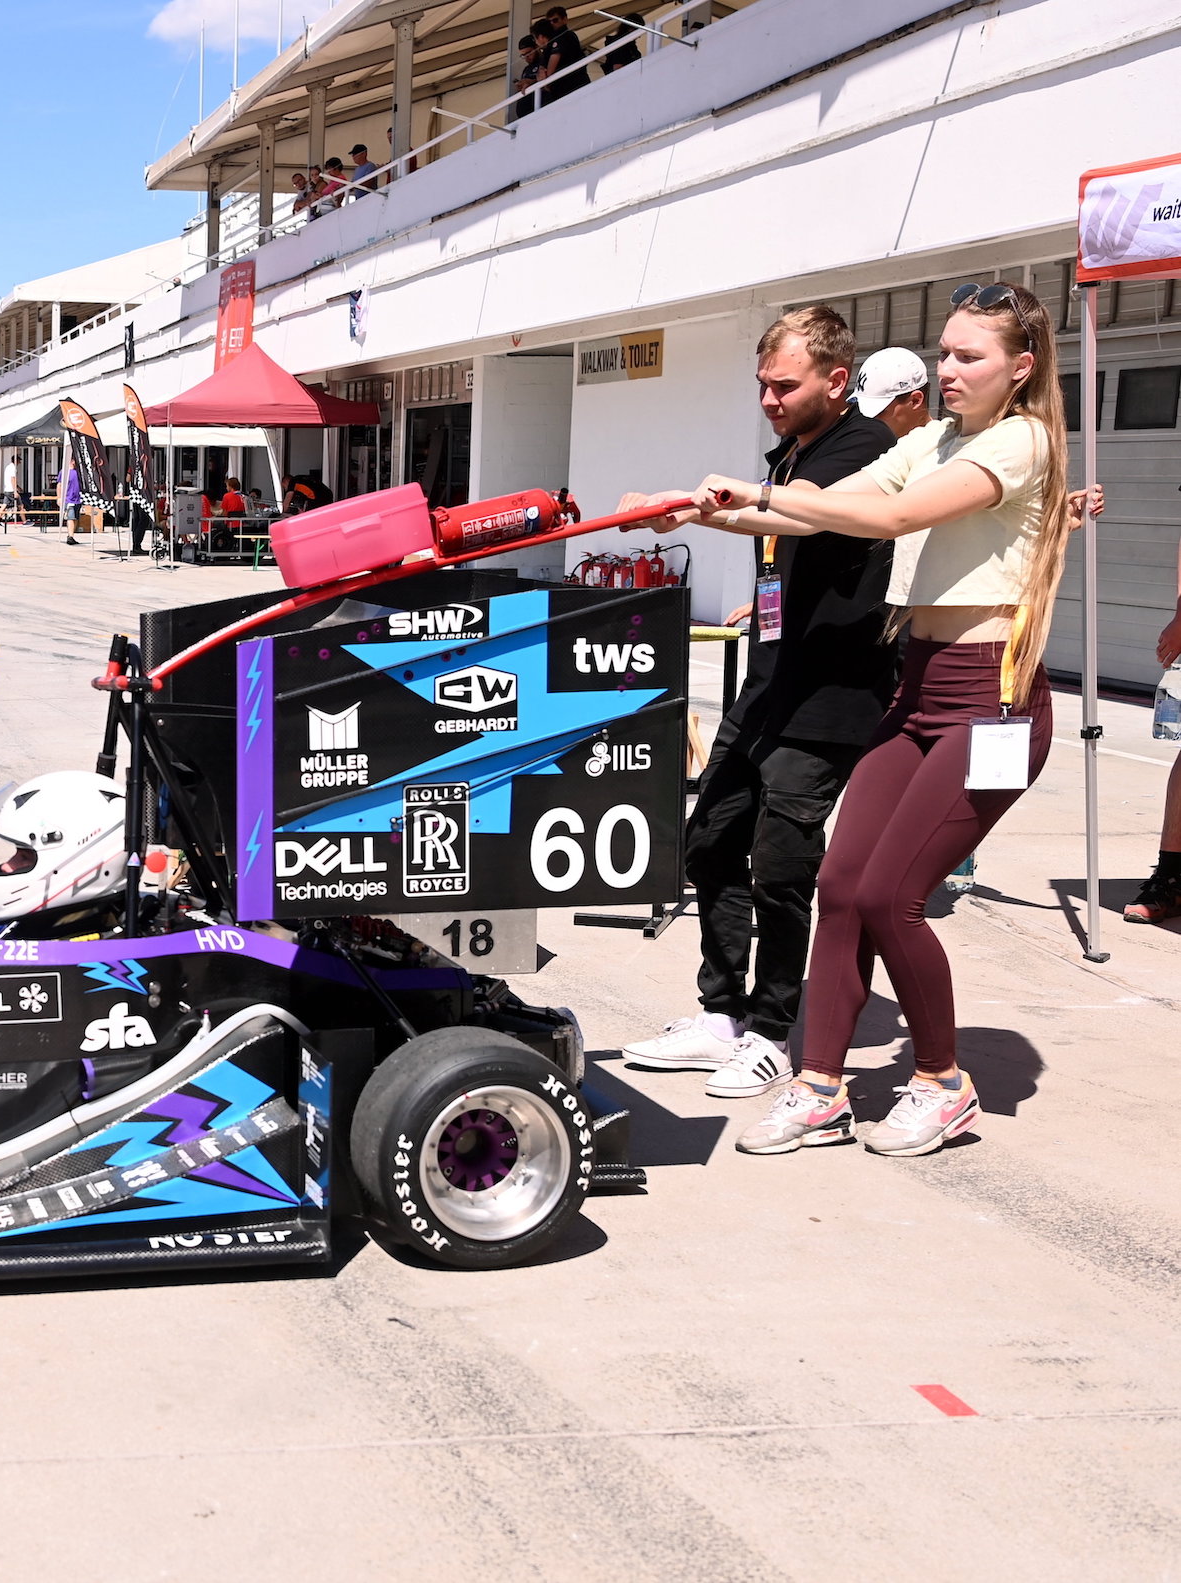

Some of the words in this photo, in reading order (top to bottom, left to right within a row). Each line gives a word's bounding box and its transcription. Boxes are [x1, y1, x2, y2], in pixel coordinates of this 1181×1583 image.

[580, 347, 618, 374] WALKWAY
[620, 352, 627, 369] &
[628, 342, 660, 369] TOILET
[388, 609, 465, 636] SHW
[421, 632, 484, 641] Automotive
[572, 637, 656, 673] tws
[434, 717, 518, 734] GEBHARDT
[300, 752, 369, 772] MÜLLER
[301, 770, 369, 788] GRUPPE
[274, 836, 388, 878] DELL
[529, 803, 652, 893] 60
[276, 880, 387, 901] Technologies
[409, 877, 464, 892] ROYCE
[3, 940, 39, 961] 22E
[194, 929, 245, 950] HVD
[442, 918, 493, 957] 18
[79, 1002, 157, 1052] sfa
[539, 1073, 594, 1191] Hoosier
[393, 1133, 451, 1252] Hoosier
